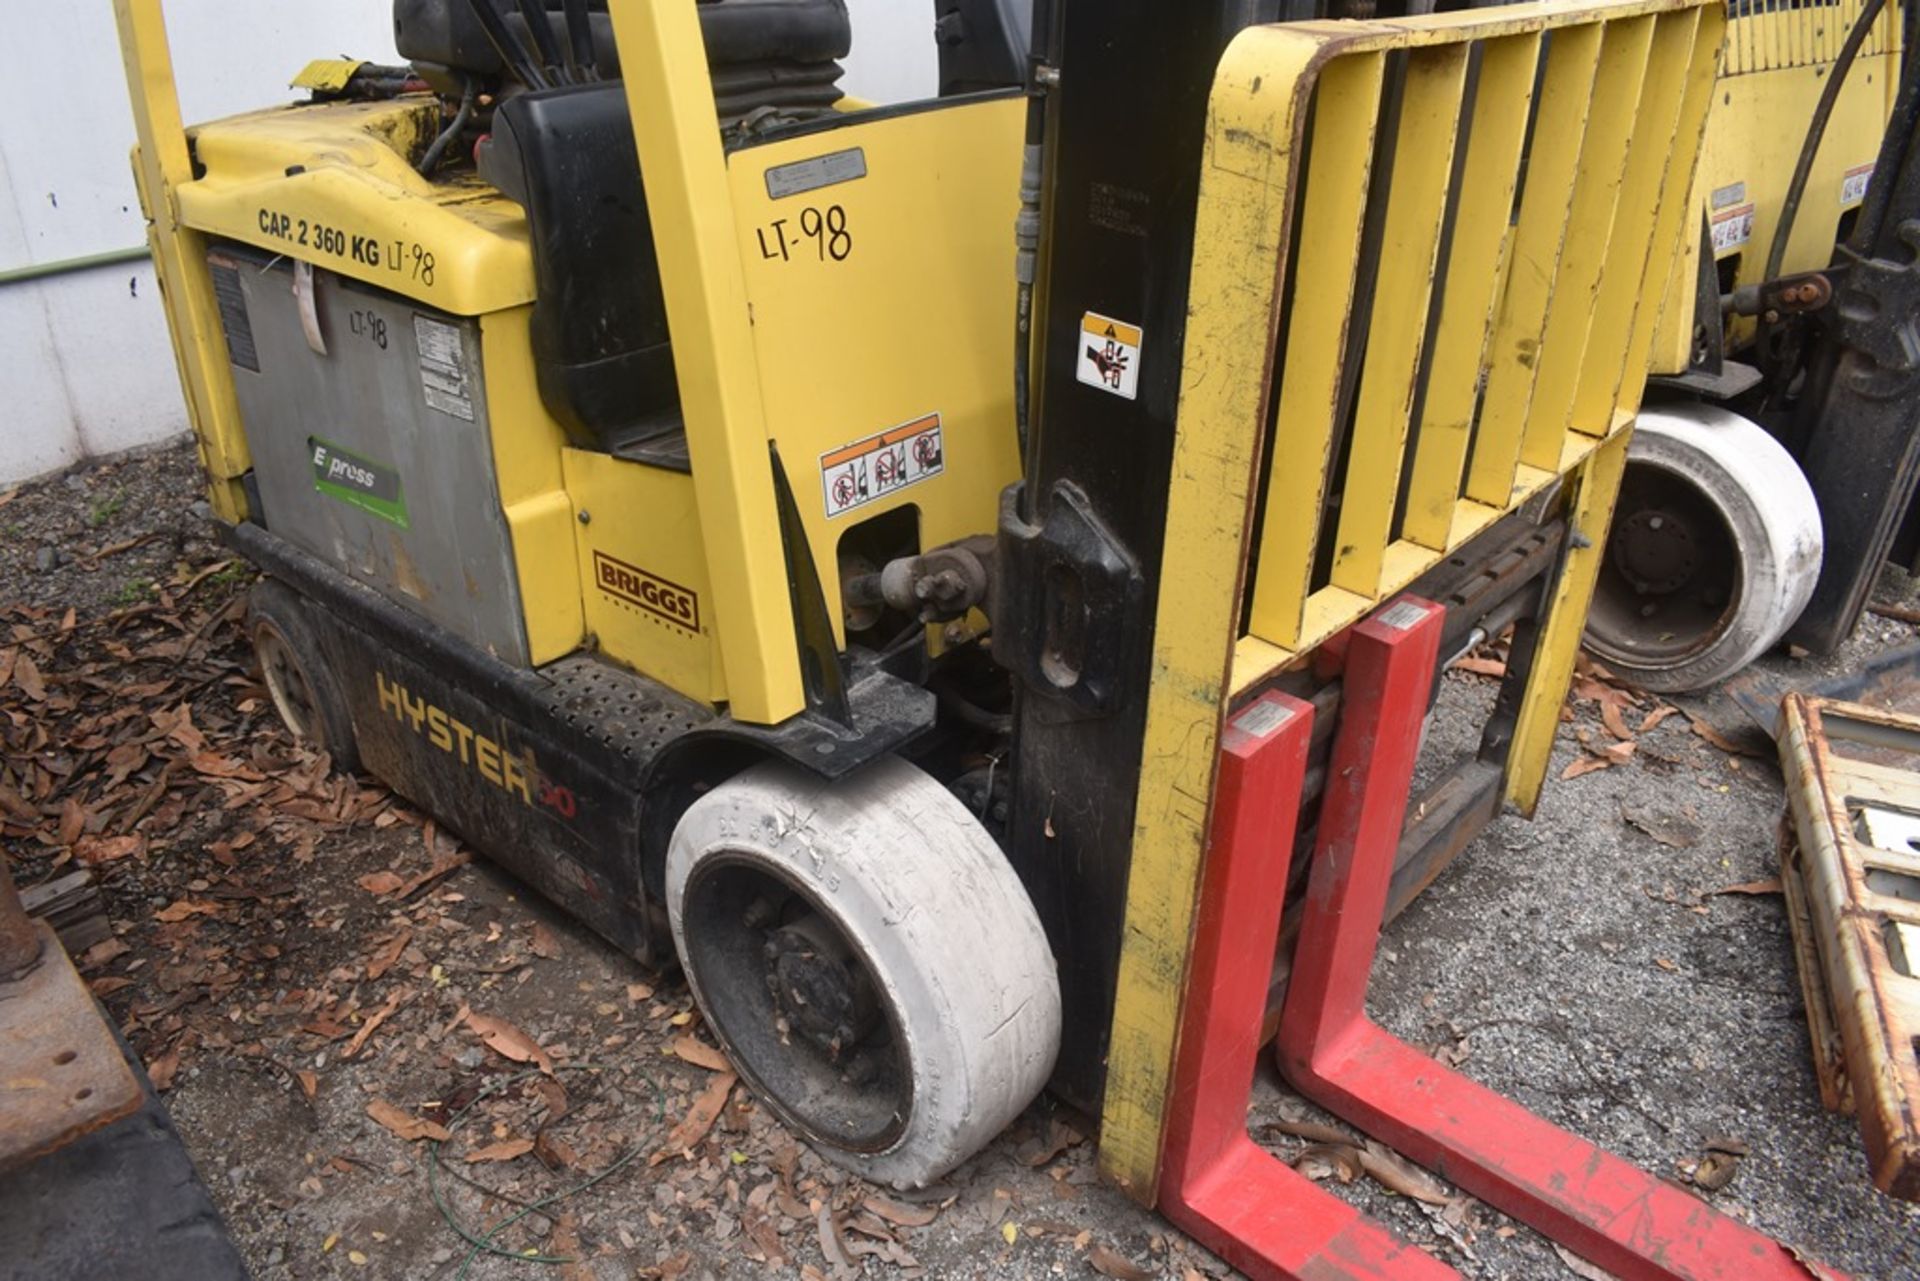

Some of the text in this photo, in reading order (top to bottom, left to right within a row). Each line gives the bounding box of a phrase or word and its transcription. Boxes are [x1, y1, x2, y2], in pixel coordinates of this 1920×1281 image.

[258, 207, 379, 267] CAP. 2 360 KG
[757, 204, 852, 262] LT-98
[387, 241, 435, 287] LT-98
[349, 310, 388, 351] LT-98
[600, 561, 692, 620] BRIGGS
[376, 671, 538, 809] HYSTER
